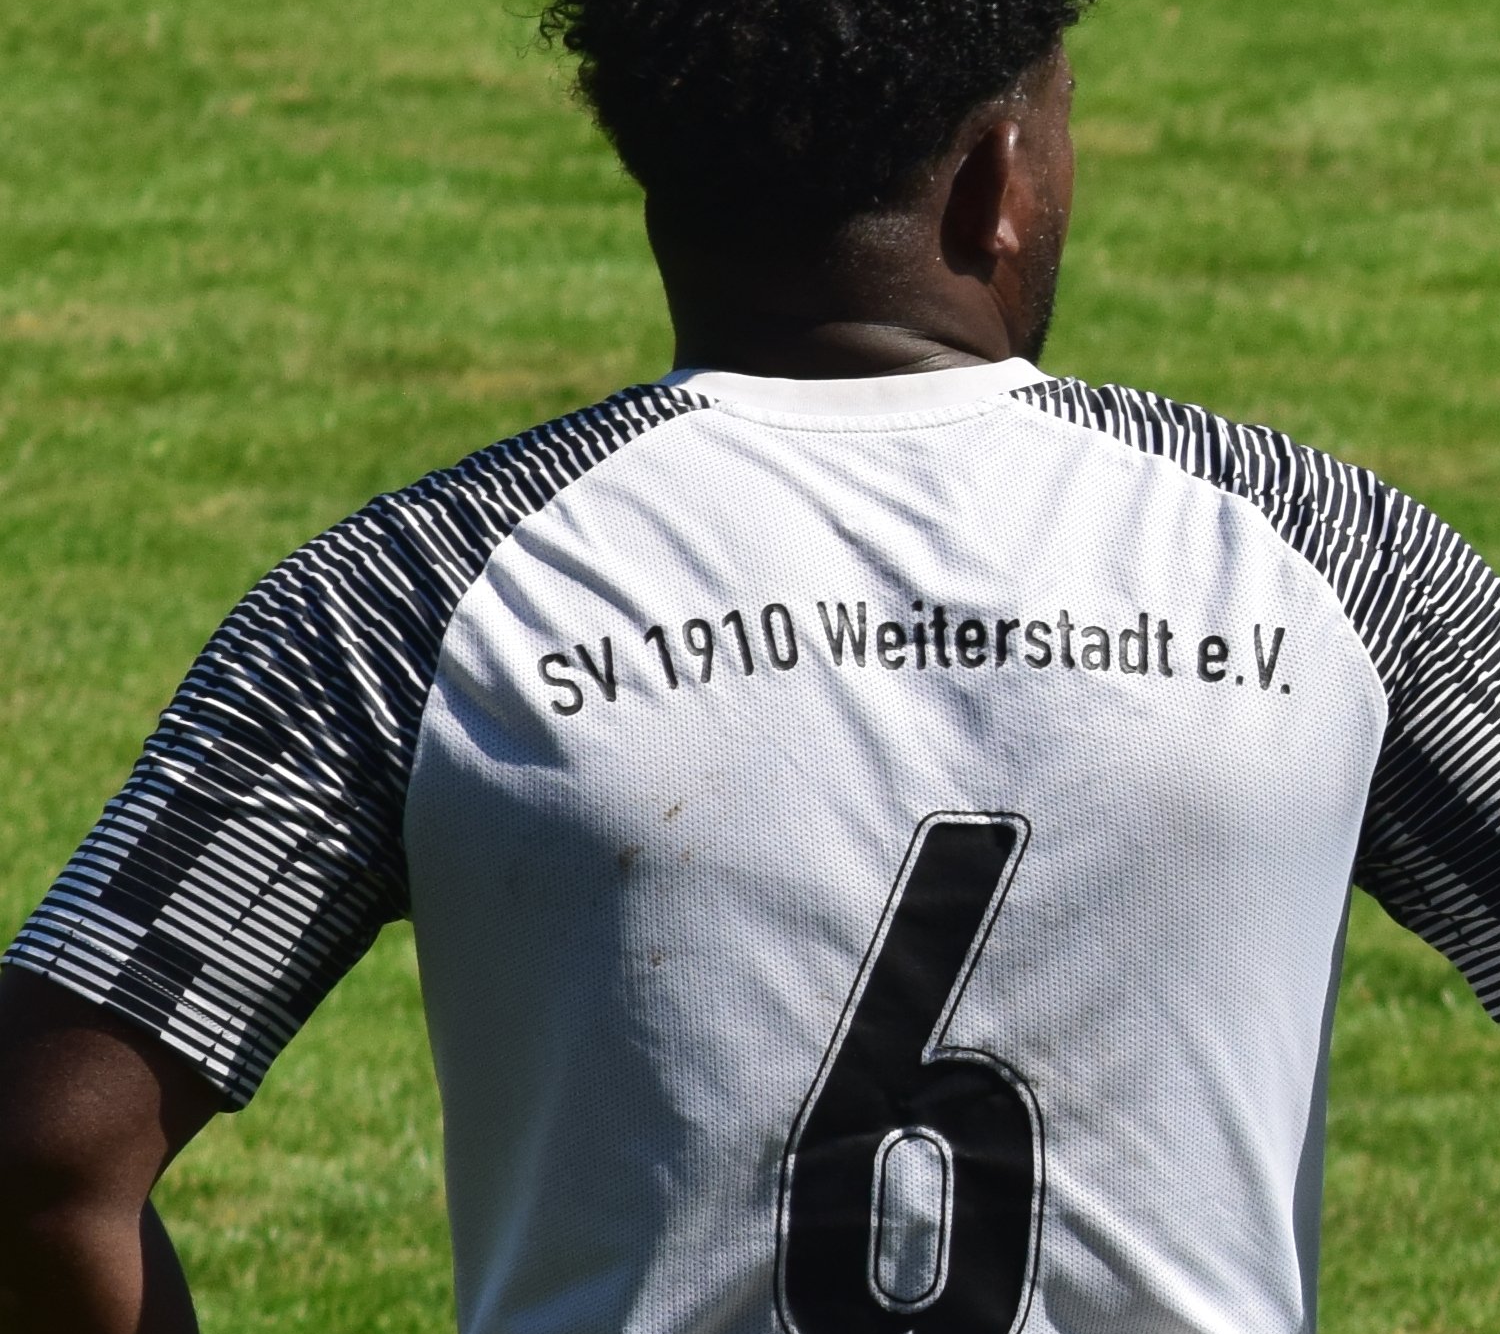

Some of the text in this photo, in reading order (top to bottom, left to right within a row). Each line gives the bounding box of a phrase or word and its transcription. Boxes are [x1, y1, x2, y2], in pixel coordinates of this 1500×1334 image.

[537, 600, 1291, 716] SV 1910 Weiterstadt e.V.
